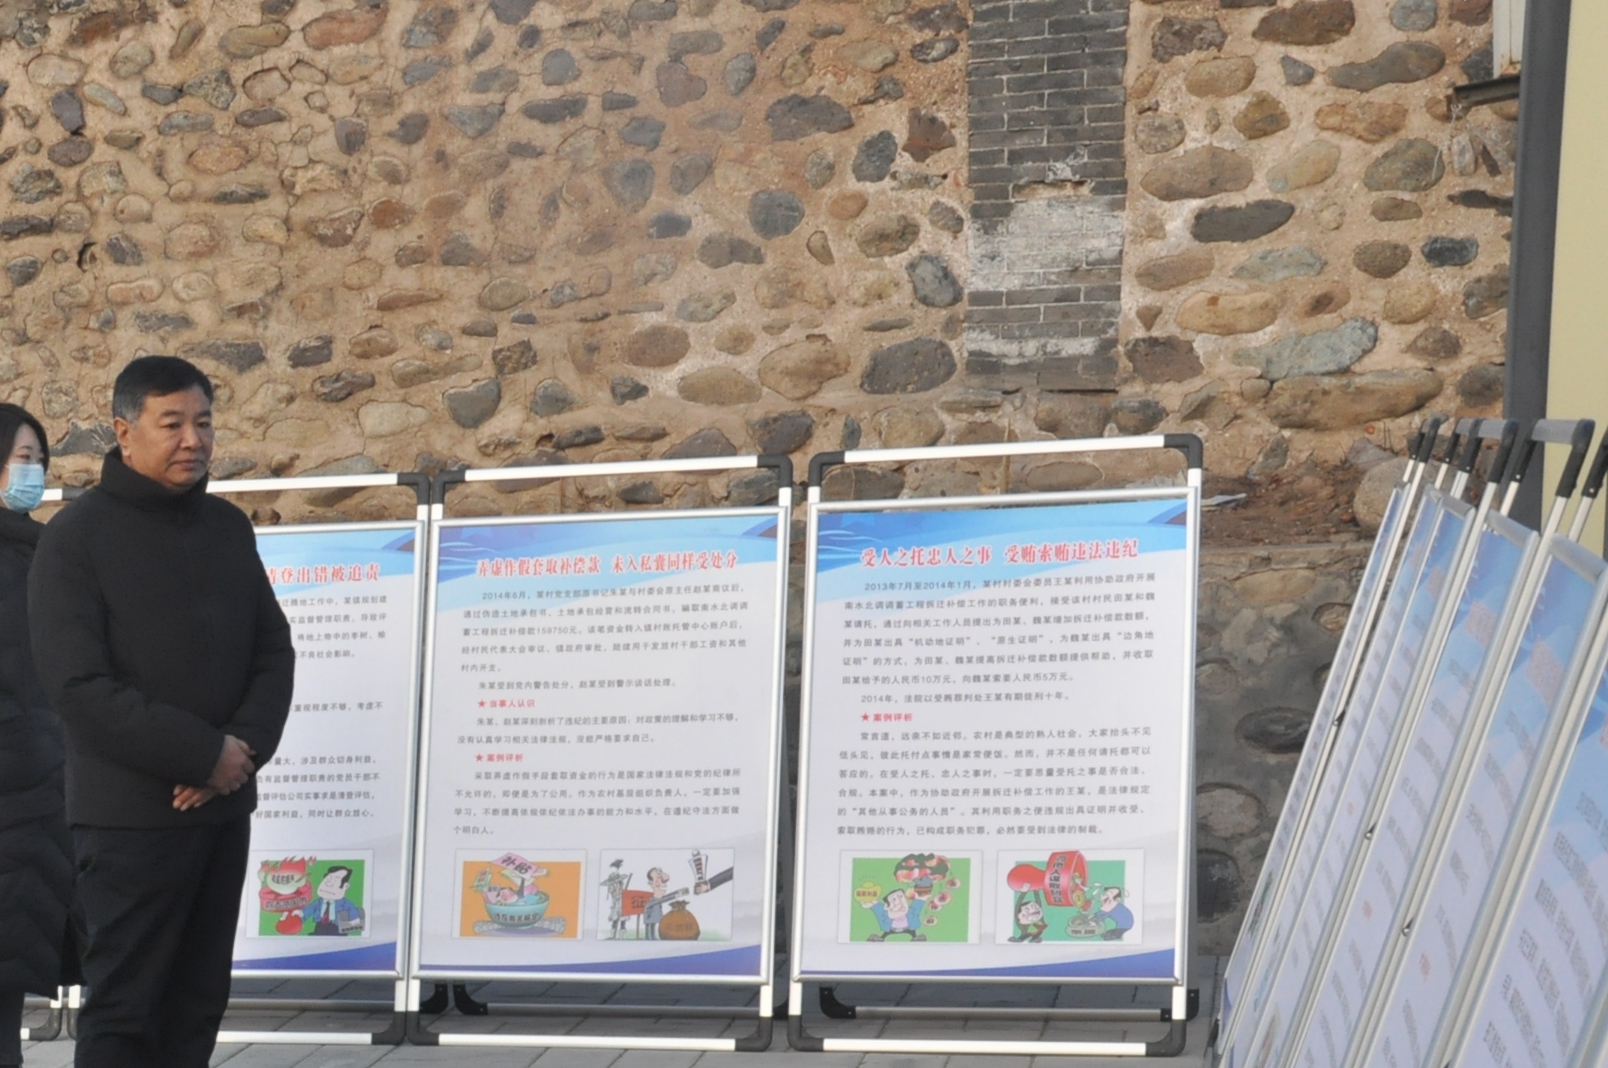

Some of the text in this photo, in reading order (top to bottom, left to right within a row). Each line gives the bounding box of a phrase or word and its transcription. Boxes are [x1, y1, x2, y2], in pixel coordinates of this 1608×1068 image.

[862, 540, 1139, 568] 受人之托忠人之事 受贿索贿违法违纪
[477, 551, 738, 577] 弄虚作假套取补偿款 未入私囊同样受处分
[489, 699, 535, 708] 当事人认识
[873, 713, 913, 722] 案例评析
[486, 753, 524, 762] 案例评析
[501, 856, 533, 876] 补贴
